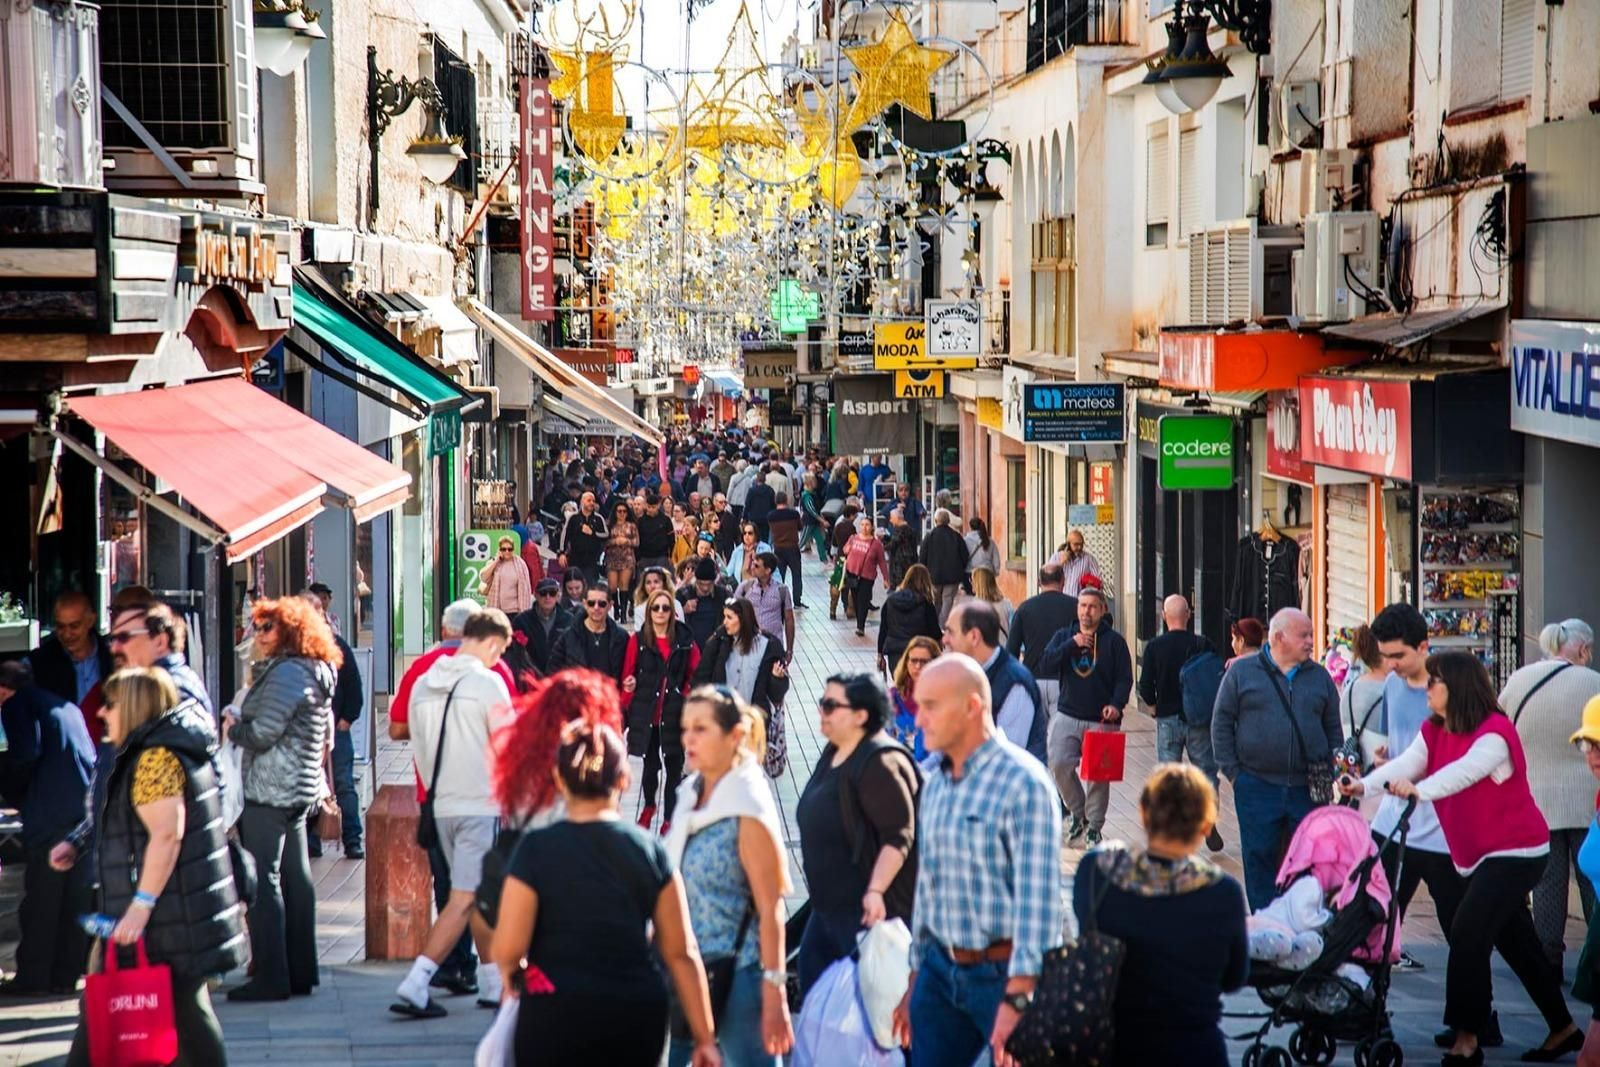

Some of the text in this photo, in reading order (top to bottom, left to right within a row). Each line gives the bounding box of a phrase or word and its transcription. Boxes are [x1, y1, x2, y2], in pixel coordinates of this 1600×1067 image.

[525, 89, 549, 311] CHANGE
[877, 344, 919, 356] MODA
[746, 364, 759, 376] LA
[1513, 345, 1600, 420] VITALDE
[903, 385, 936, 396] ATM
[842, 400, 909, 416] Asport
[1063, 396, 1115, 409] mateos
[1163, 439, 1231, 455] codere
